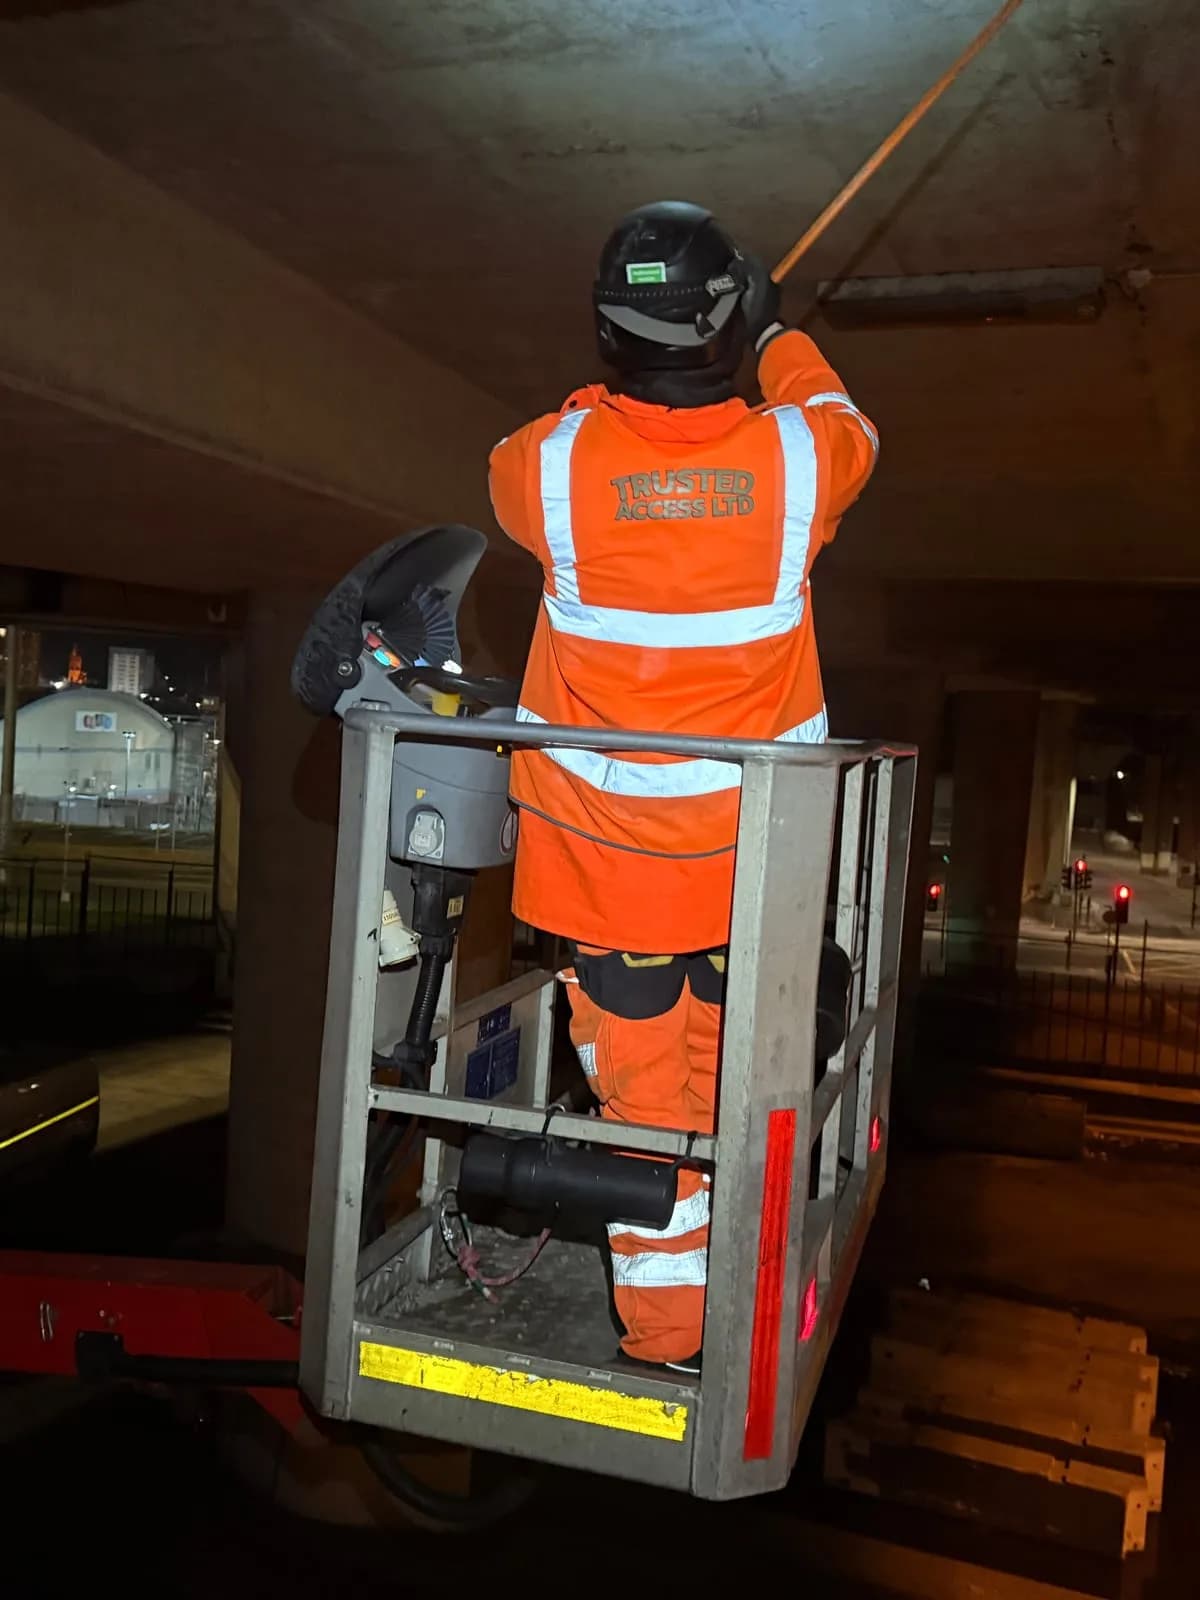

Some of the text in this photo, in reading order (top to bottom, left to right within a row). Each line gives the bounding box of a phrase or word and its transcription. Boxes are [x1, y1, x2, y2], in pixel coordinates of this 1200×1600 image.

[610, 468, 755, 500] TRUSTED
[615, 495, 755, 521] ACCESS LTD
